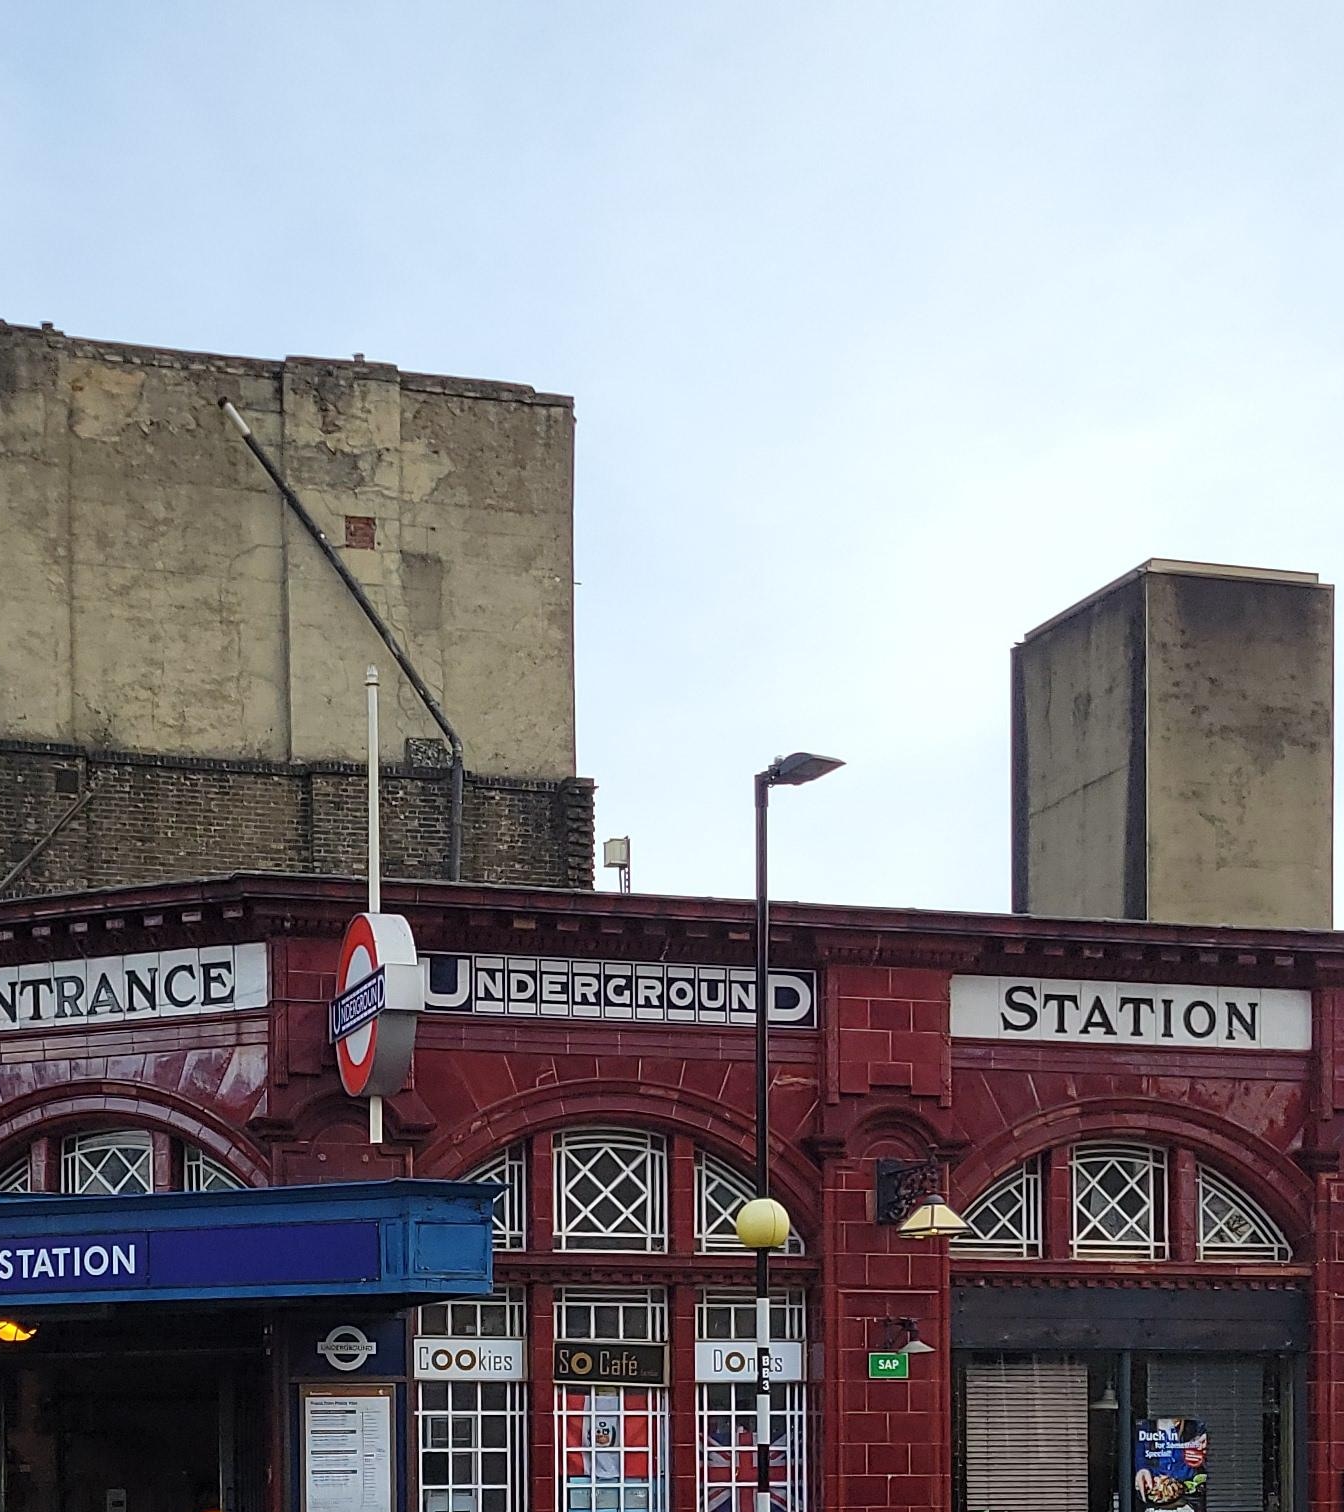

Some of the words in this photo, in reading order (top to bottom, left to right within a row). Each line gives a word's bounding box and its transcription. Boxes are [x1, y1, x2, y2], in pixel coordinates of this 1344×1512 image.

[420, 953, 812, 1022] UNDERGROUND
[333, 974, 386, 1035] UNDERGROUND
[999, 985, 1260, 1042] STATION
[320, 1344, 373, 1352] UNDERGROUND
[599, 1351, 638, 1376] Café
[878, 1359, 899, 1370] SAP
[1138, 1431, 1165, 1441] Duck
